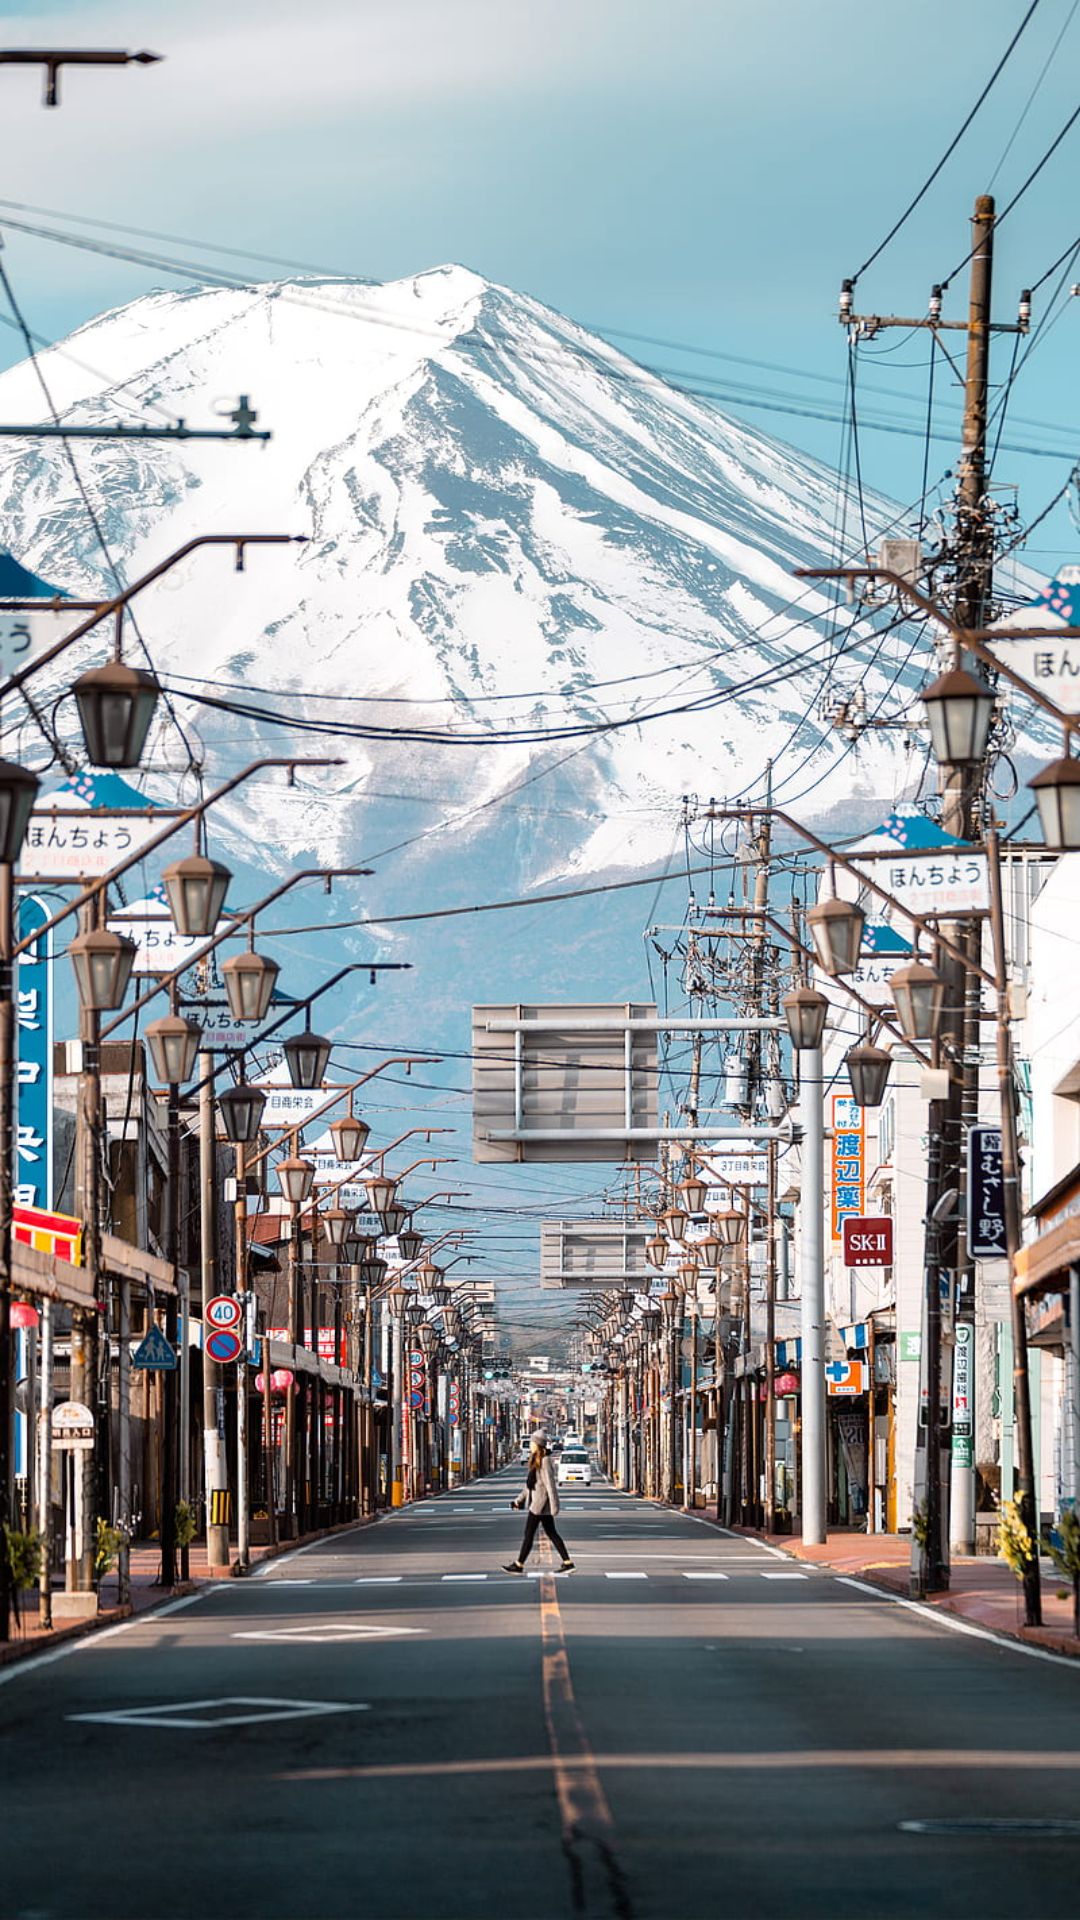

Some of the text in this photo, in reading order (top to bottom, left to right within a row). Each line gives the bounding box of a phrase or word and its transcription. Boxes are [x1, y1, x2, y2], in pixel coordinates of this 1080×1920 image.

[0, 622, 32, 654] う
[1033, 650, 1080, 678] ほん
[25, 825, 132, 850] ほんちょう
[889, 861, 981, 888] ほんちょう
[849, 1233, 887, 1251] SK-II
[214, 1305, 233, 1320] 40
